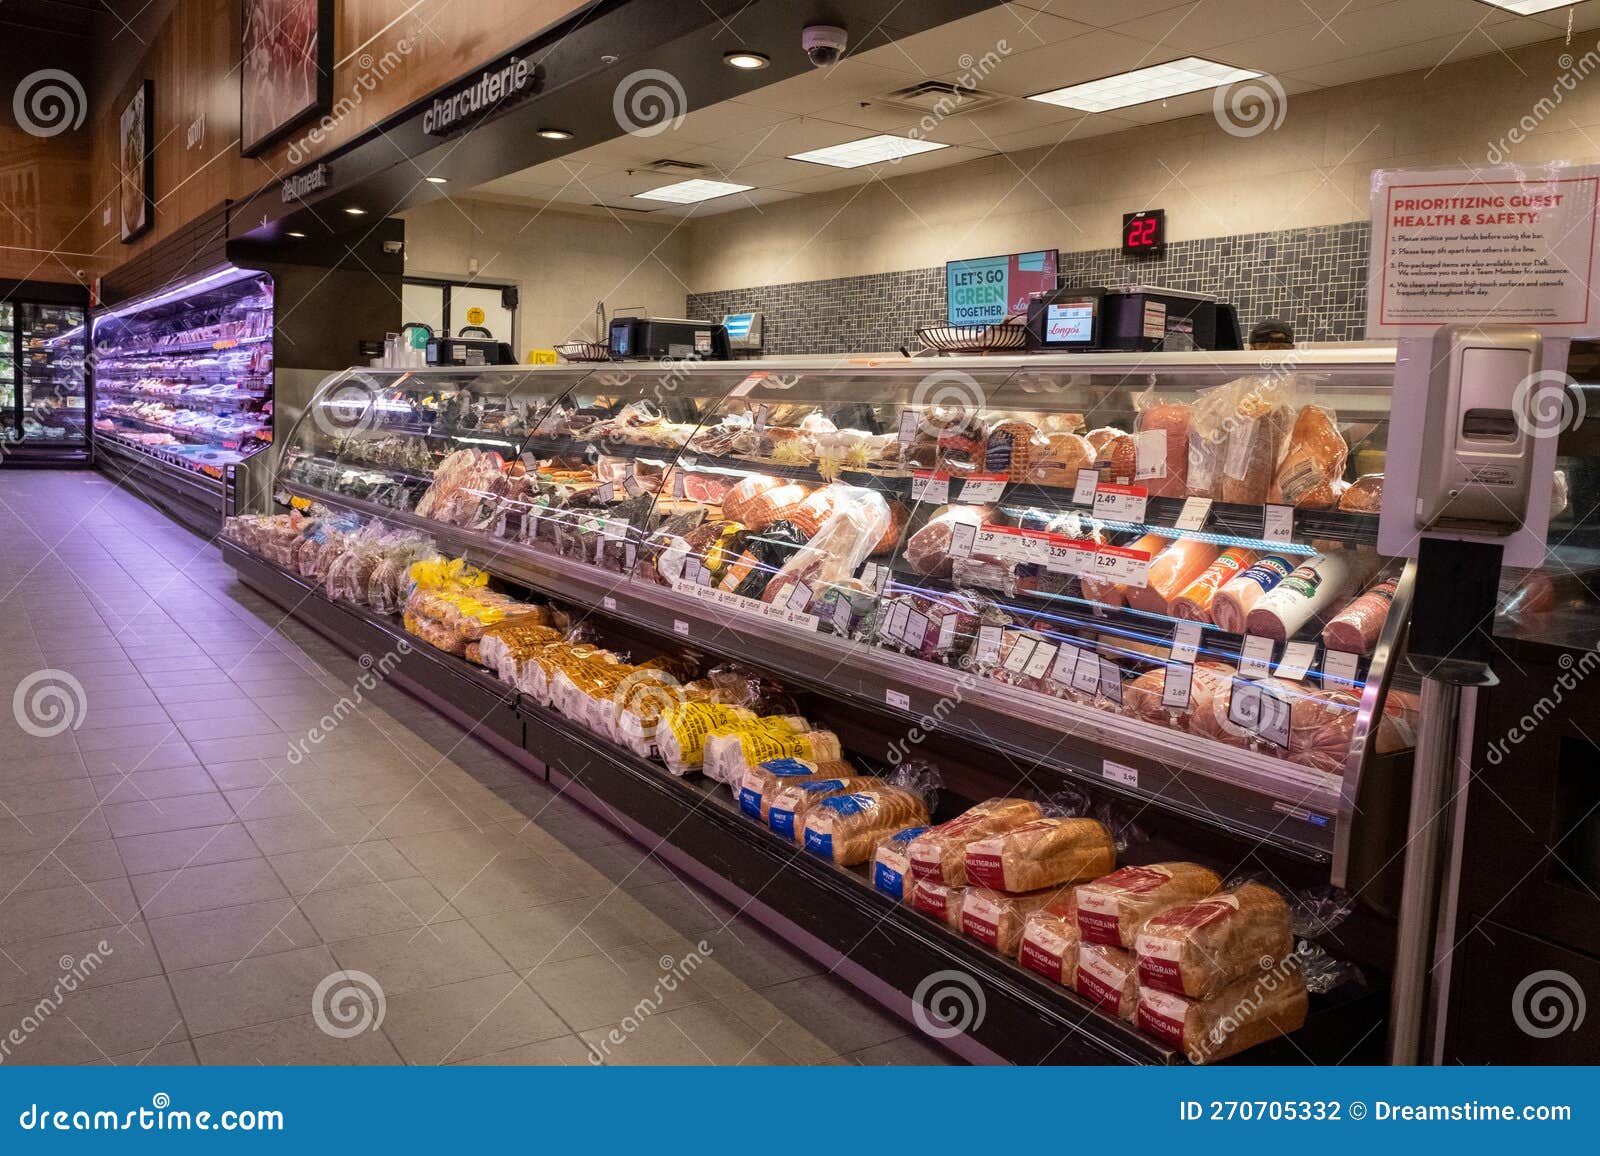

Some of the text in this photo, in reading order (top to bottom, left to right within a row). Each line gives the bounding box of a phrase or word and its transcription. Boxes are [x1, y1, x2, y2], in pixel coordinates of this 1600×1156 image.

[423, 57, 529, 134] charcuterie
[1394, 194, 1563, 211] PRIORITIZING GUEST
[1393, 214, 1456, 227] HEALTH
[1460, 213, 1471, 226] &
[1128, 218, 1157, 247] 22
[1460, 232, 1479, 240] hands
[1480, 232, 1501, 240] before
[1502, 233, 1519, 241] using
[1520, 231, 1531, 239] the
[1420, 247, 1436, 255] keep
[1465, 245, 1481, 253] from
[1482, 245, 1502, 253] others
[954, 270, 1004, 286] LET'S GO
[1499, 279, 1525, 287] surfaces
[1526, 279, 1538, 287] and
[1539, 279, 1564, 287] utensils
[954, 285, 1004, 305] GREEN
[1396, 289, 1427, 297] frequently
[1429, 288, 1463, 297] throughout
[1465, 287, 1475, 296] the
[955, 305, 1005, 318] TOGETHER.
[1096, 494, 1116, 504] 2.49
[1273, 528, 1290, 536] 4.49
[1049, 546, 1067, 557] 3.29
[1096, 556, 1117, 567] 2.29
[965, 858, 1000, 869] MULTIGRAIN
[963, 918, 996, 937] MULTIGRAIN
[1078, 915, 1115, 929] MULTIGRAIN
[1023, 944, 1060, 969] MULTIGRAIN
[1078, 972, 1118, 1003] MULTIGRAIN
[1139, 1007, 1181, 1035] MULTIGRAIN
